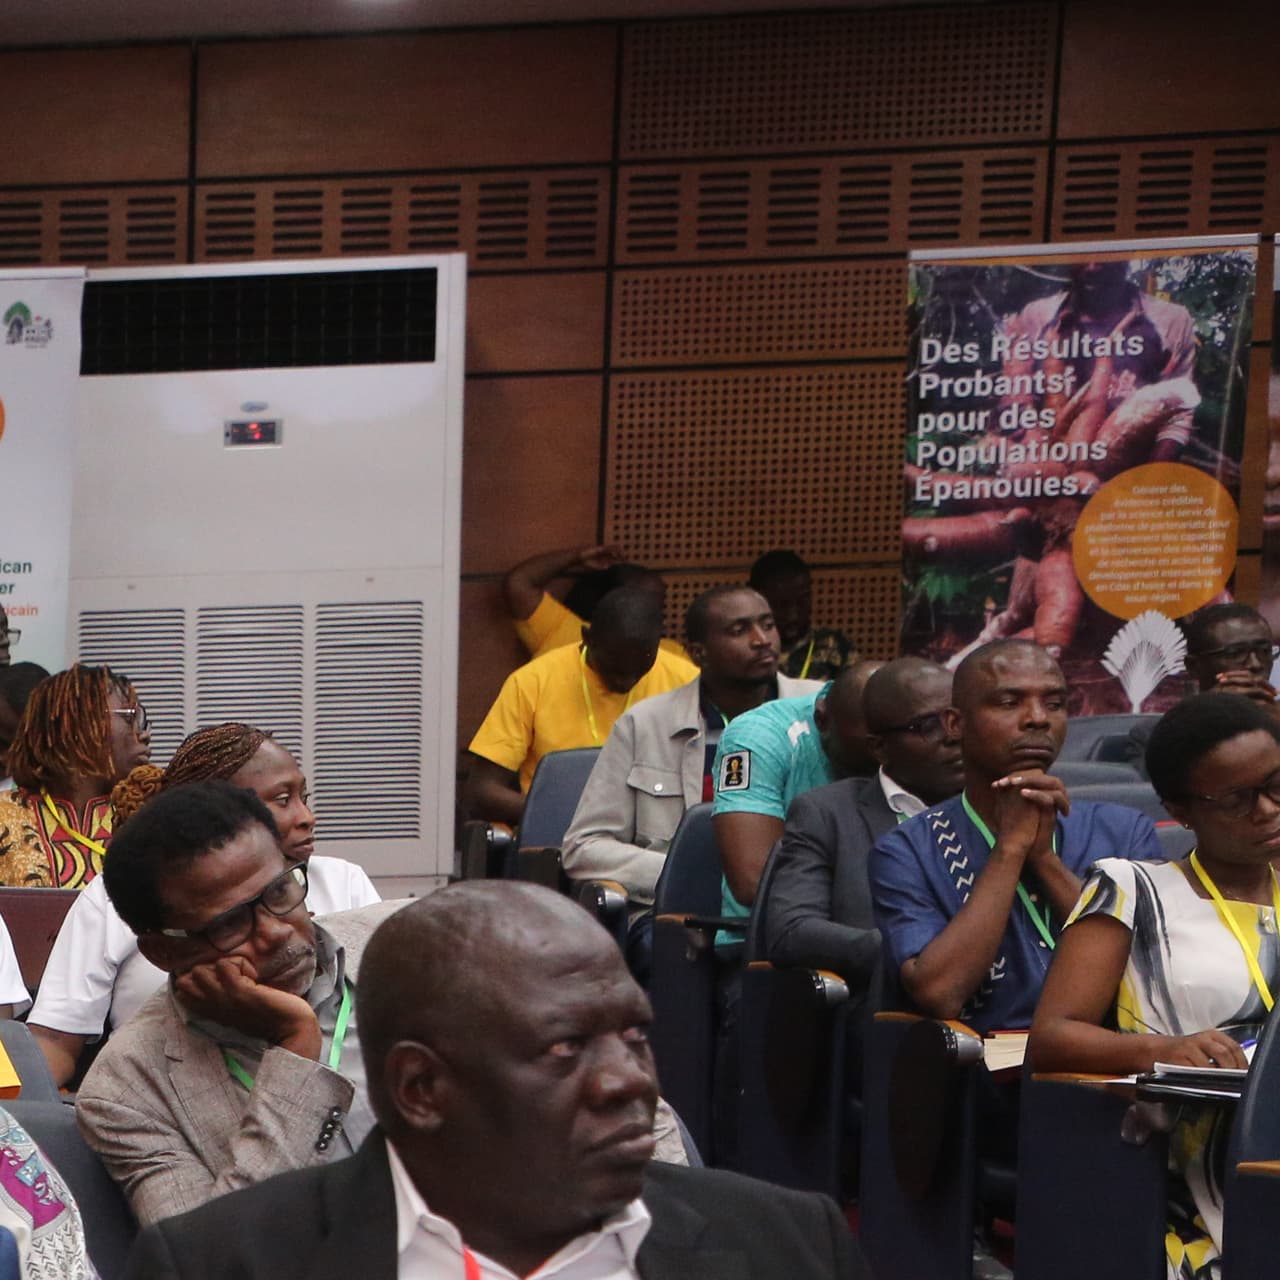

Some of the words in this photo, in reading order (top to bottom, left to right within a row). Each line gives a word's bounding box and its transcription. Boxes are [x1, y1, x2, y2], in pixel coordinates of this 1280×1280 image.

[921, 338, 980, 365] Des
[991, 331, 1144, 362] Résultats
[917, 411, 989, 439] pour
[999, 403, 1056, 430] des
[917, 436, 1108, 472] Populations
